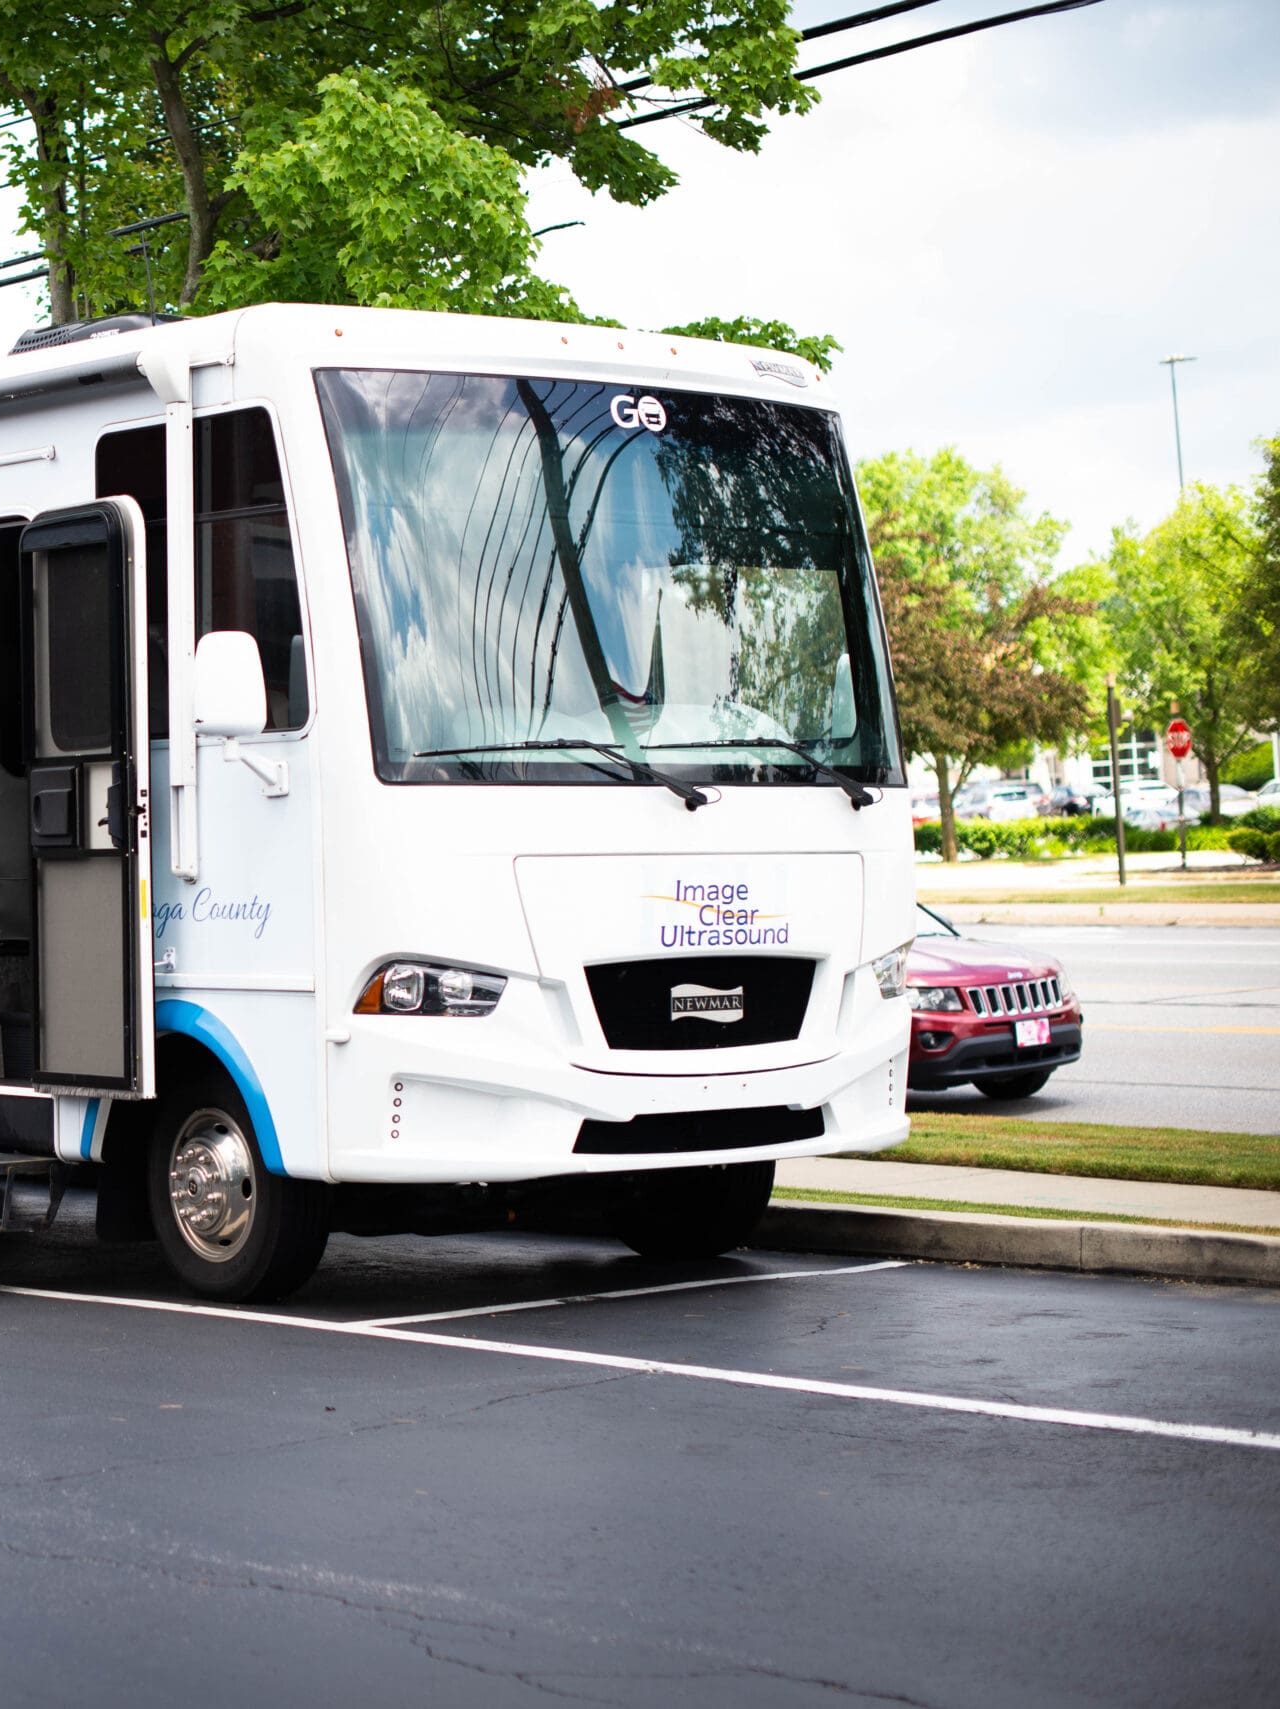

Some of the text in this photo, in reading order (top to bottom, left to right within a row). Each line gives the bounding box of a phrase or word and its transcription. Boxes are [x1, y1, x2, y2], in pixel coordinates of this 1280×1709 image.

[675, 879, 749, 905] Image
[192, 887, 272, 939] County
[698, 904, 759, 927] Clear
[660, 923, 789, 948] Ultrasound
[674, 997, 741, 1011] NEWMAR
